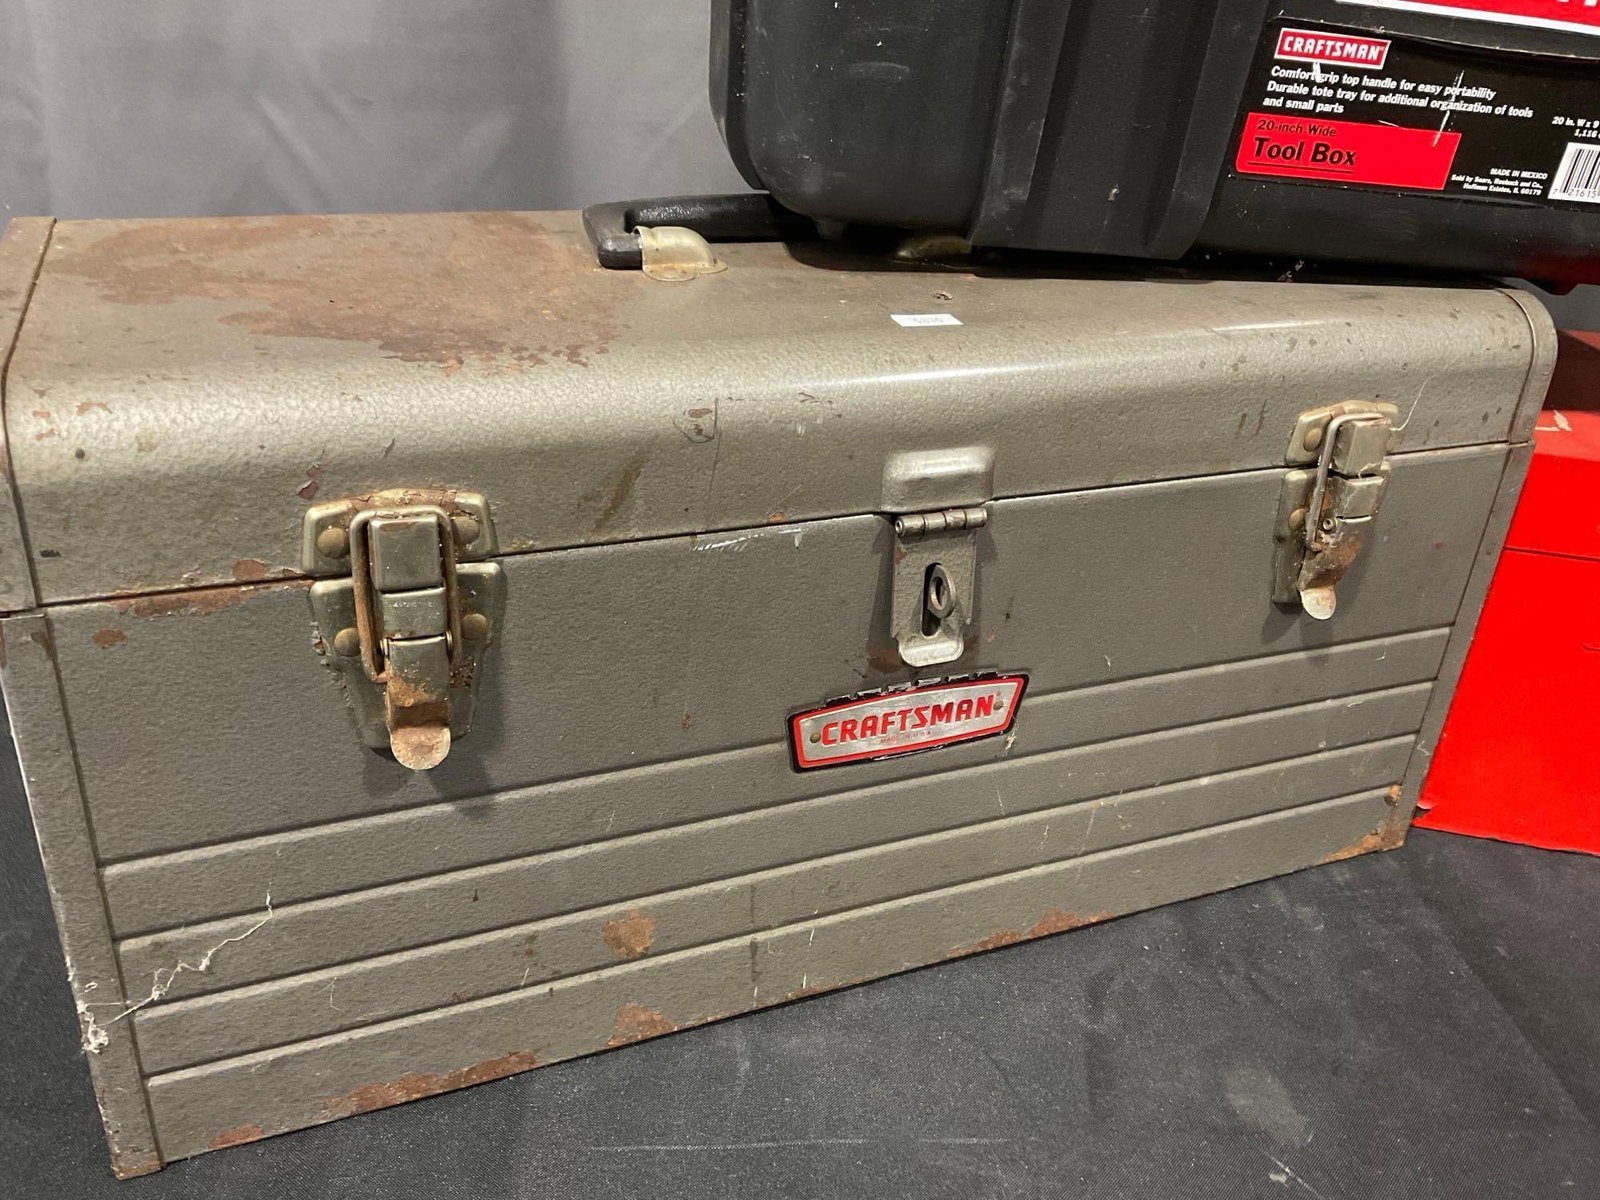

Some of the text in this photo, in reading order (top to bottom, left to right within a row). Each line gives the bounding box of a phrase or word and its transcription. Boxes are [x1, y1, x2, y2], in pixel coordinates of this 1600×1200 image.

[1283, 36, 1381, 60] CRAFTSMAN
[1342, 74, 1360, 87] top
[1361, 75, 1397, 89] handle
[1400, 79, 1416, 91] for
[1417, 83, 1442, 95] easy
[1443, 86, 1496, 100] portability
[1262, 97, 1345, 113] and small parts
[1267, 80, 1534, 118] Durable tote tray for additional organization of tools
[1257, 119, 1337, 137] 20-inch Wide
[1551, 116, 1565, 125] 20
[1576, 118, 1586, 127] W
[1592, 120, 1600, 129] 9
[1254, 136, 1357, 166] Tool Box
[1465, 175, 1474, 183] by
[1490, 168, 1511, 177] MADE
[1520, 171, 1548, 180] MEXICO
[1520, 188, 1542, 196] 60179
[821, 694, 995, 746] CRAFTSMAN
